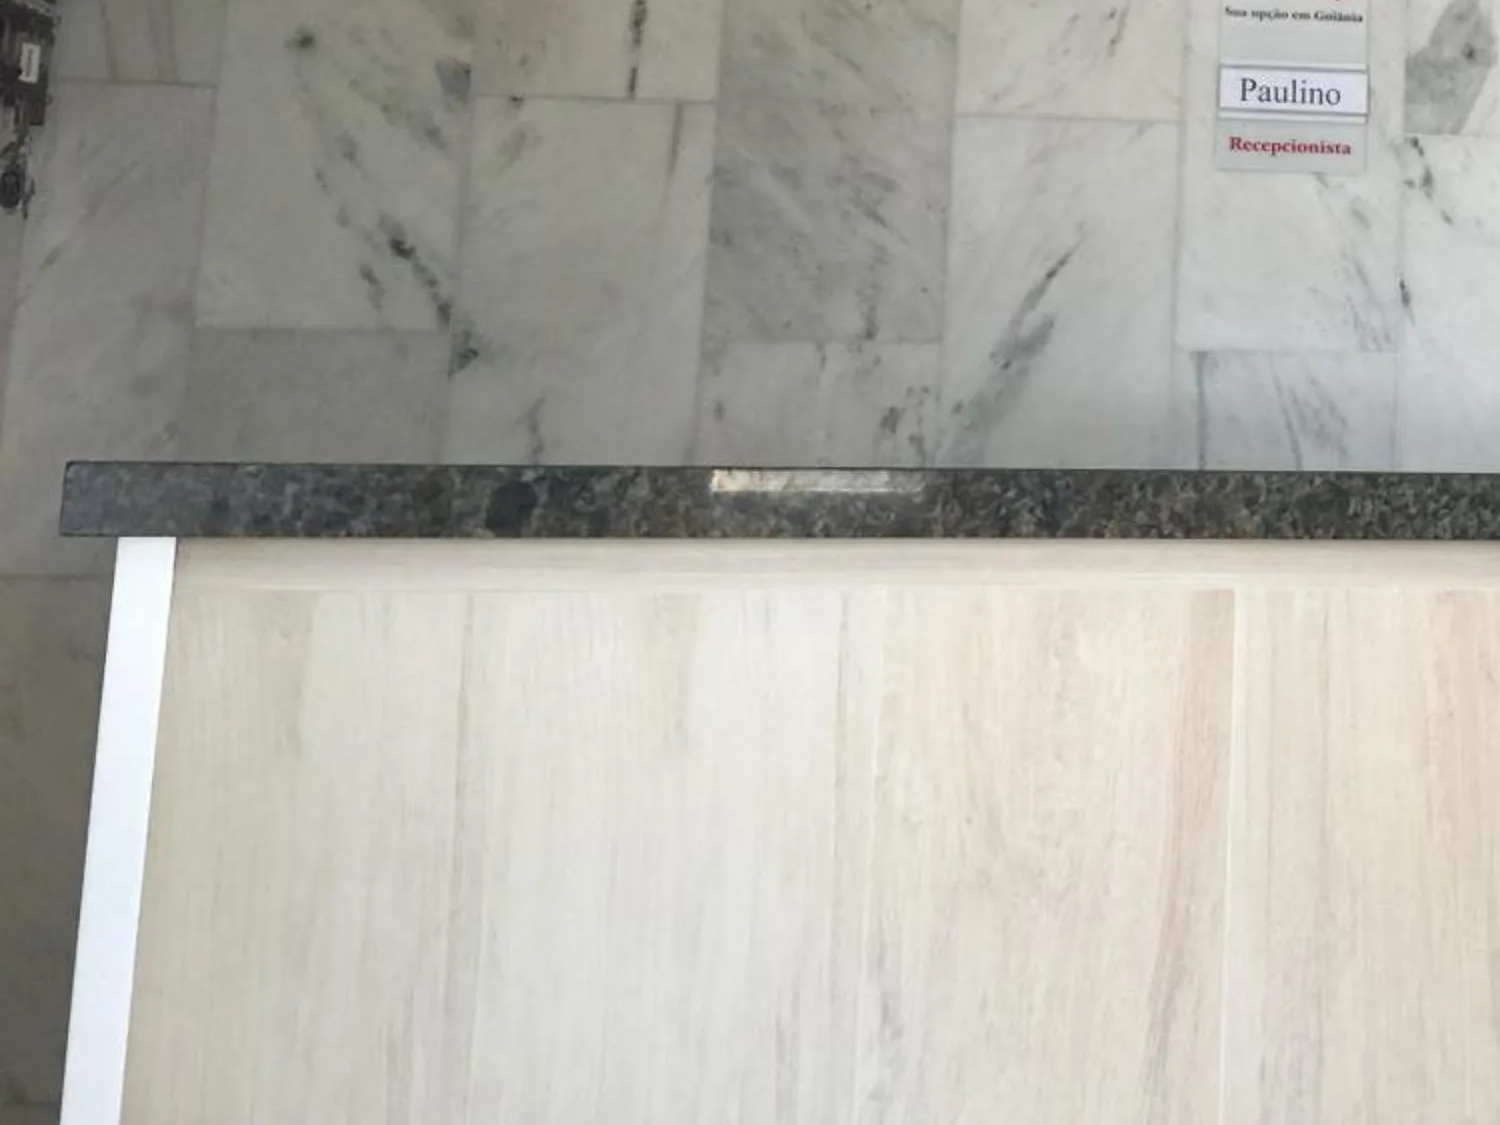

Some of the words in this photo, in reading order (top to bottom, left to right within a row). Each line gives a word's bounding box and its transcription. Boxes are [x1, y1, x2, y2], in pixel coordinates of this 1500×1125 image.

[1225, 6, 1247, 18] Sua
[1313, 9, 1363, 23] Goiânia
[1240, 77, 1341, 106] Paulino
[1229, 136, 1352, 156] Recepcionista
